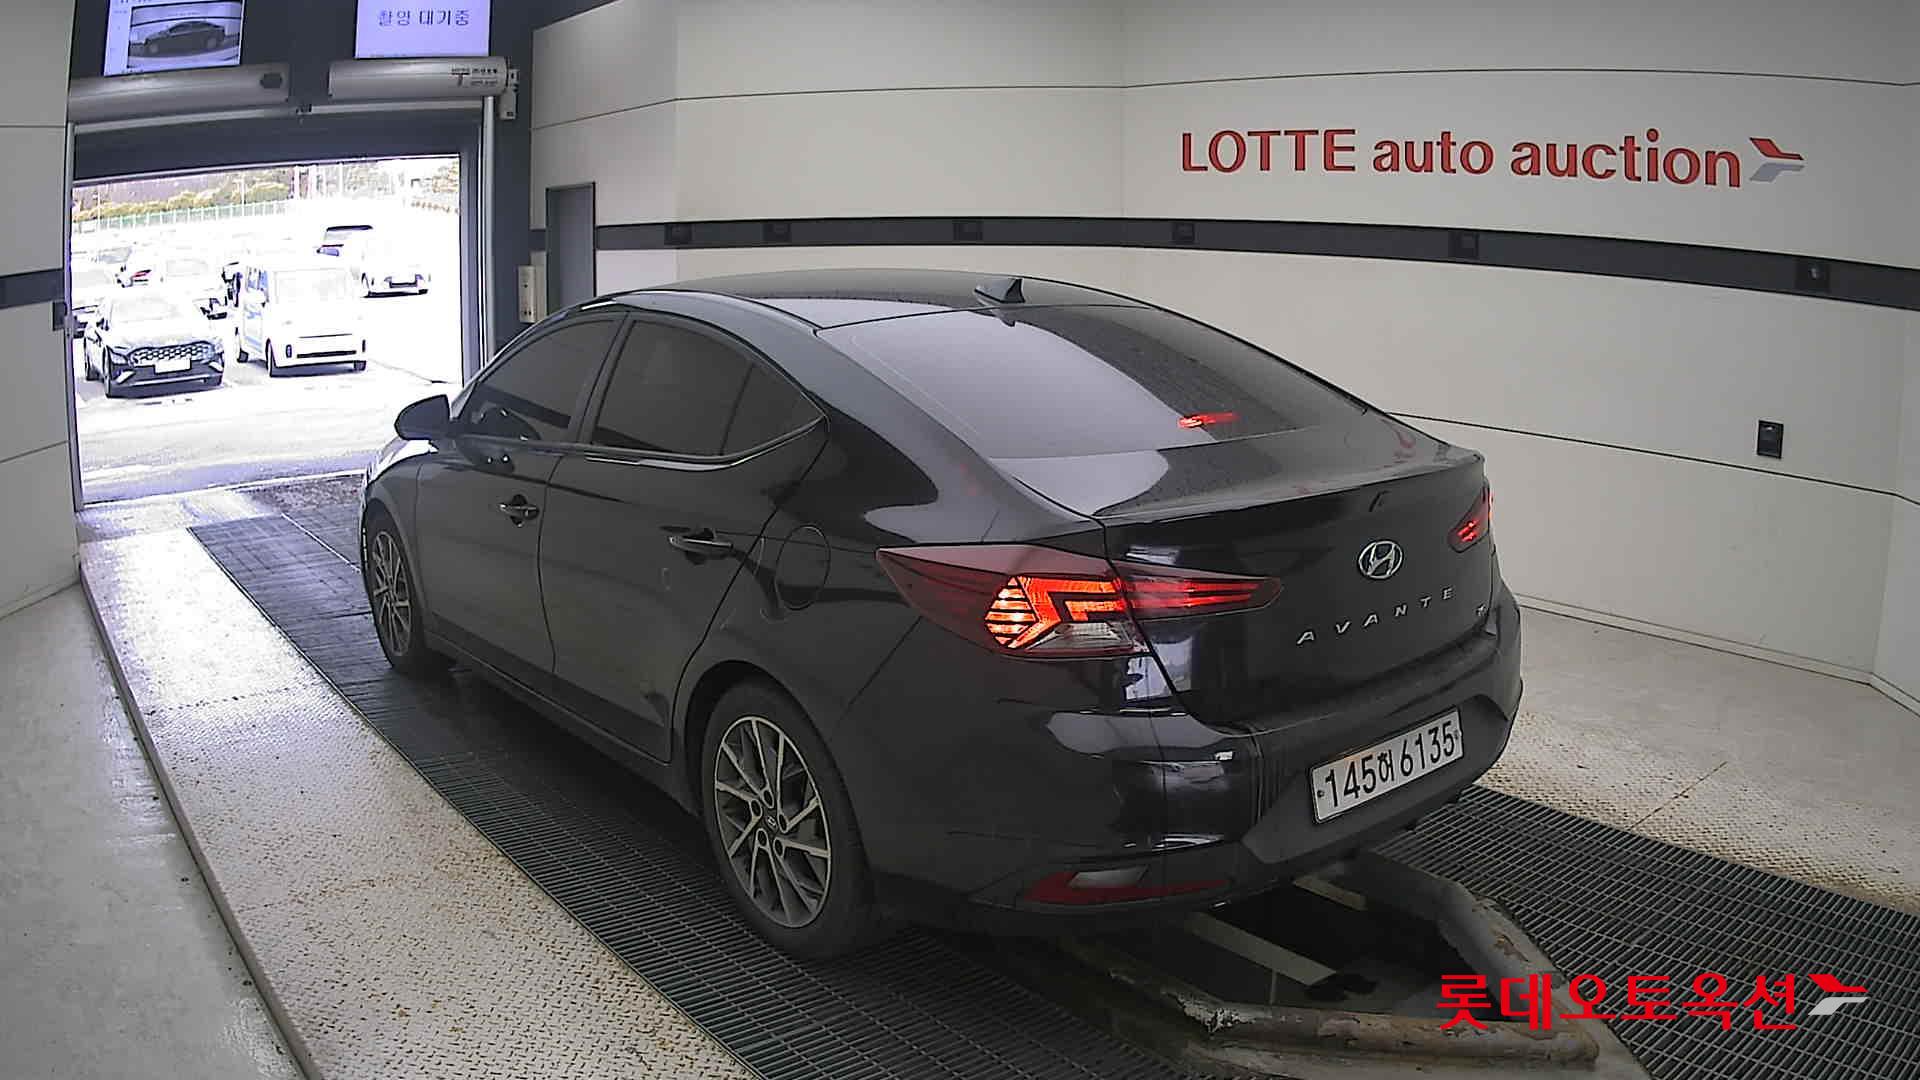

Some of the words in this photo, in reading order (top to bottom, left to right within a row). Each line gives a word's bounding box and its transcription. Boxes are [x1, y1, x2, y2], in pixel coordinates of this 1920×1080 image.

[418, 9, 470, 26] 대기중
[1182, 129, 1356, 173] LOTTE
[1373, 131, 1494, 175] auto
[1511, 128, 1742, 187] auction
[1296, 586, 1455, 645] AVANTE
